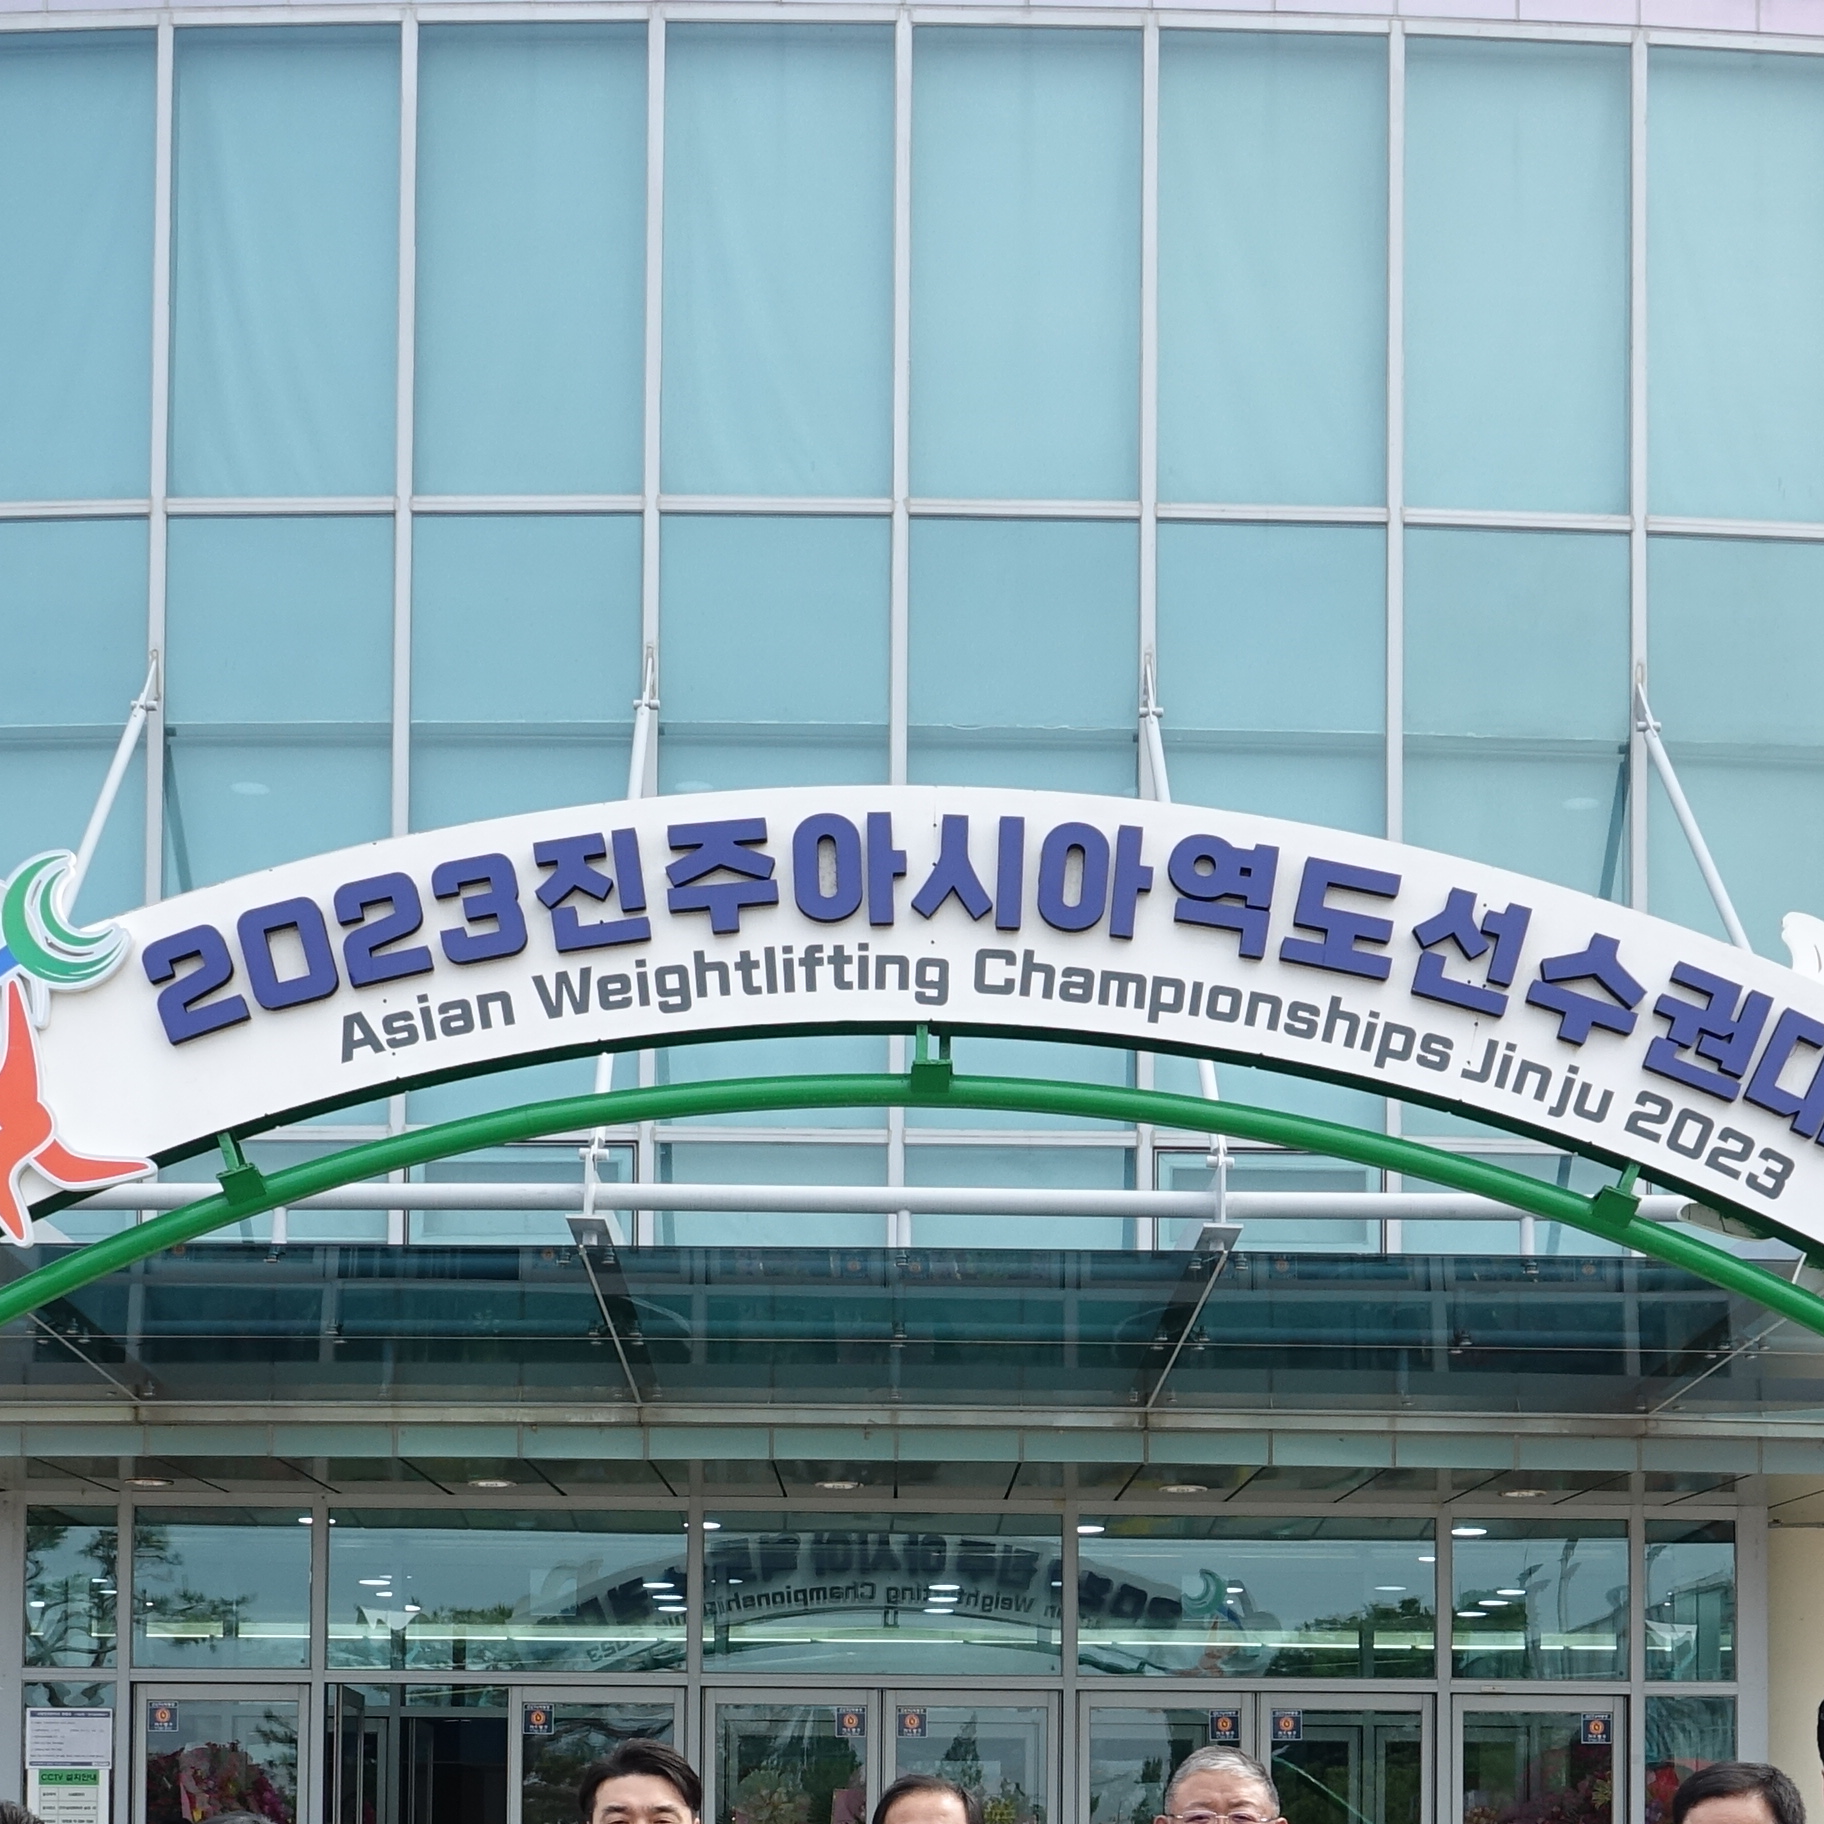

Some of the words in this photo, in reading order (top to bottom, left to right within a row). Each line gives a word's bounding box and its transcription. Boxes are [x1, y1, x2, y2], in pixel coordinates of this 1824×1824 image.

[340, 989, 516, 1064] Asian
[531, 938, 950, 1021] Weightlifting
[974, 946, 1452, 1075] Championships
[1461, 1038, 1613, 1124] Jinju
[1622, 1088, 1796, 1203] 2023
[40, 1773, 64, 1782] CCTV
[65, 1772, 97, 1782] 설치안내
